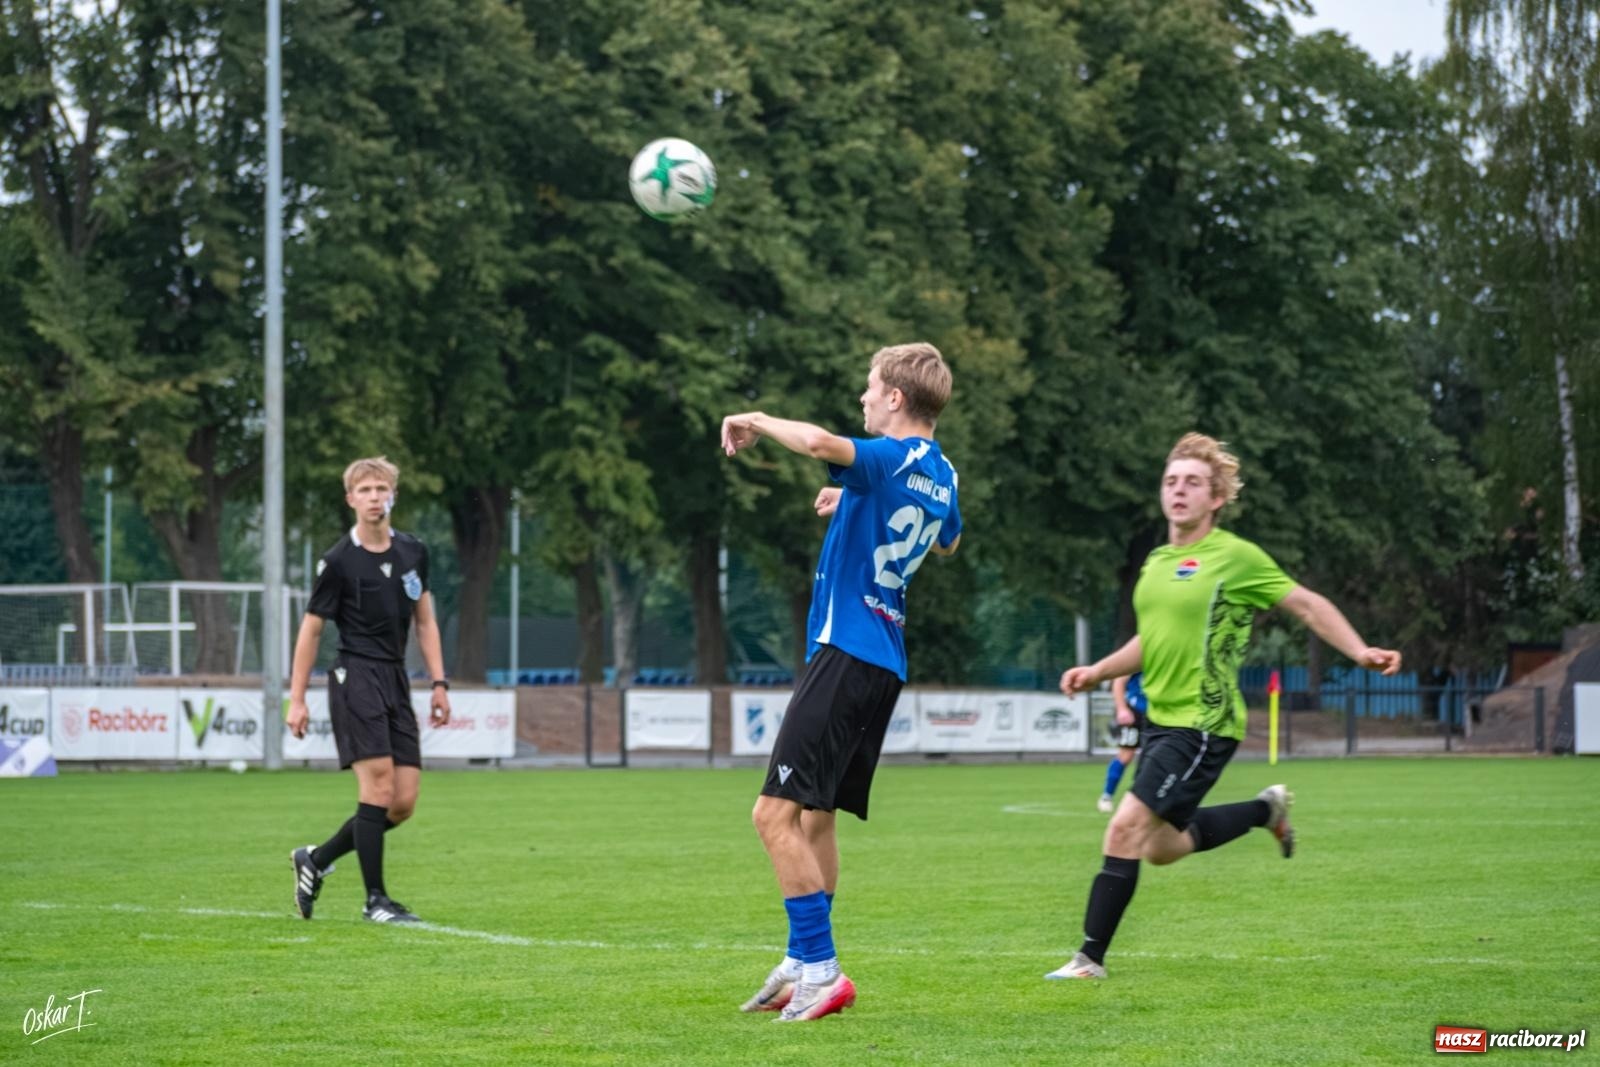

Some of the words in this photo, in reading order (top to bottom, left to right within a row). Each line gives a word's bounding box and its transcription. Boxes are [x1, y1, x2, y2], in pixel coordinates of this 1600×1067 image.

[906, 472, 934, 496] UNIA
[873, 504, 942, 590] 22
[88, 705, 168, 732] Racibórz
